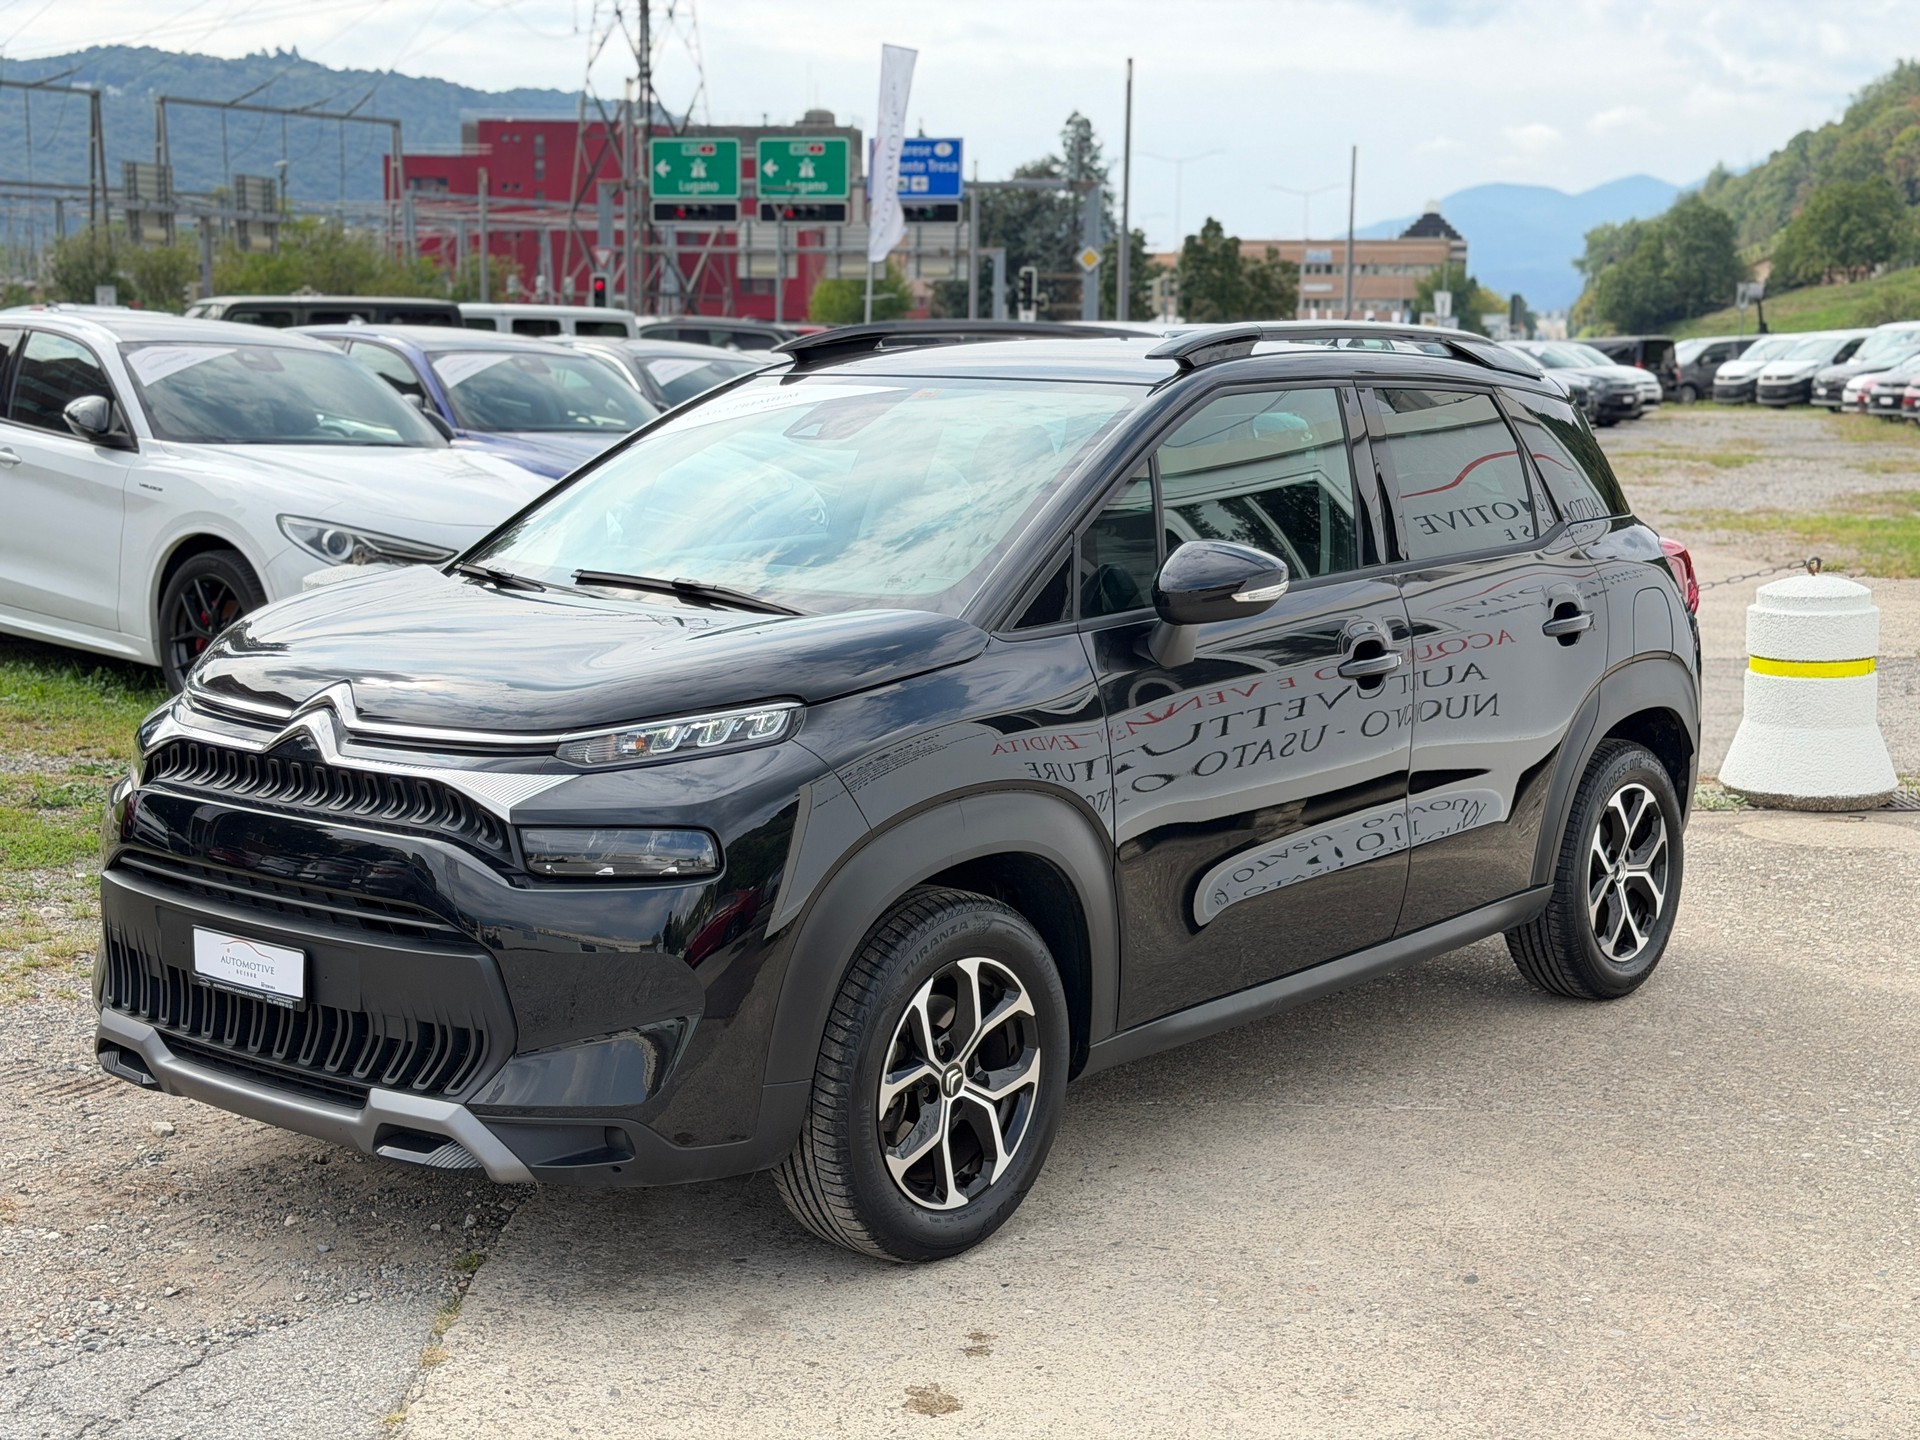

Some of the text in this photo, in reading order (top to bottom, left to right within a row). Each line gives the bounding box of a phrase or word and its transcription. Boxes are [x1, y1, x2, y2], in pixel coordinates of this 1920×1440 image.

[927, 158, 958, 173] Tresa
[678, 180, 720, 194] Lugano
[899, 920, 970, 979] TURANZA
[220, 955, 276, 976] AUTOMOTIVE
[235, 968, 258, 979] SUISSE
